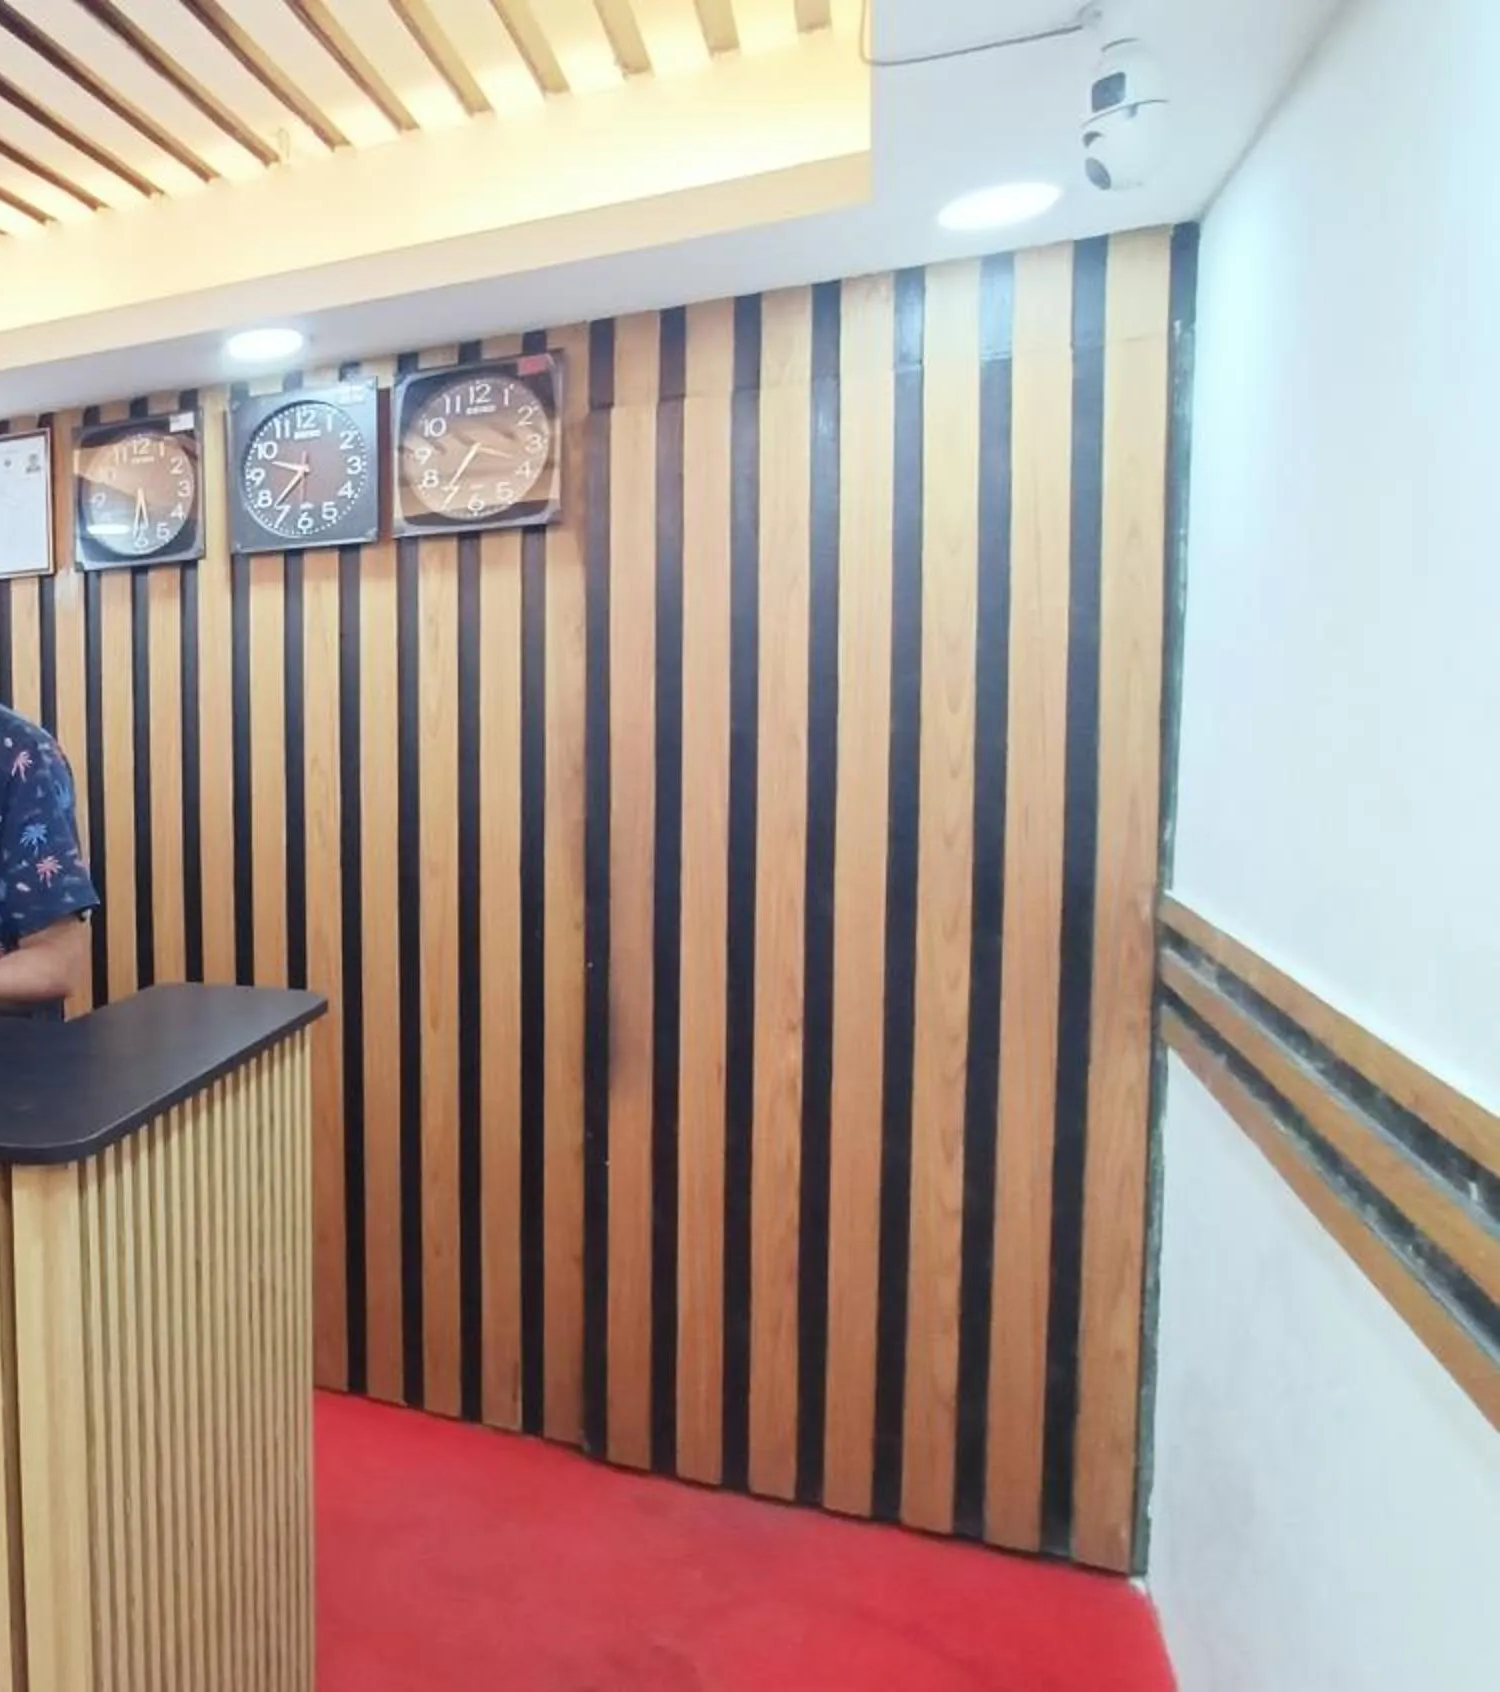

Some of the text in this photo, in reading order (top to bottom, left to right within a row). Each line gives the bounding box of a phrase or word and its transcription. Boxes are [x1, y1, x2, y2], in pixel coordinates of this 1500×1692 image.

[469, 383, 491, 405] 12
[443, 394, 461, 414] 11
[296, 410, 316, 429] 12
[517, 406, 533, 426] 2
[274, 418, 290, 439] 11
[424, 417, 447, 437] 10
[340, 431, 355, 449] 2
[525, 434, 543, 452] 3
[257, 441, 277, 459] 10
[415, 448, 431, 465] 9
[347, 456, 362, 474] 3
[515, 461, 532, 479] 4
[250, 468, 265, 486] 9
[423, 469, 439, 488] 8
[258, 490, 272, 507] 8
[337, 481, 354, 499] 4
[496, 482, 513, 499] 5
[322, 502, 338, 520] 5
[468, 495, 484, 511] 6
[297, 512, 313, 529] 6
